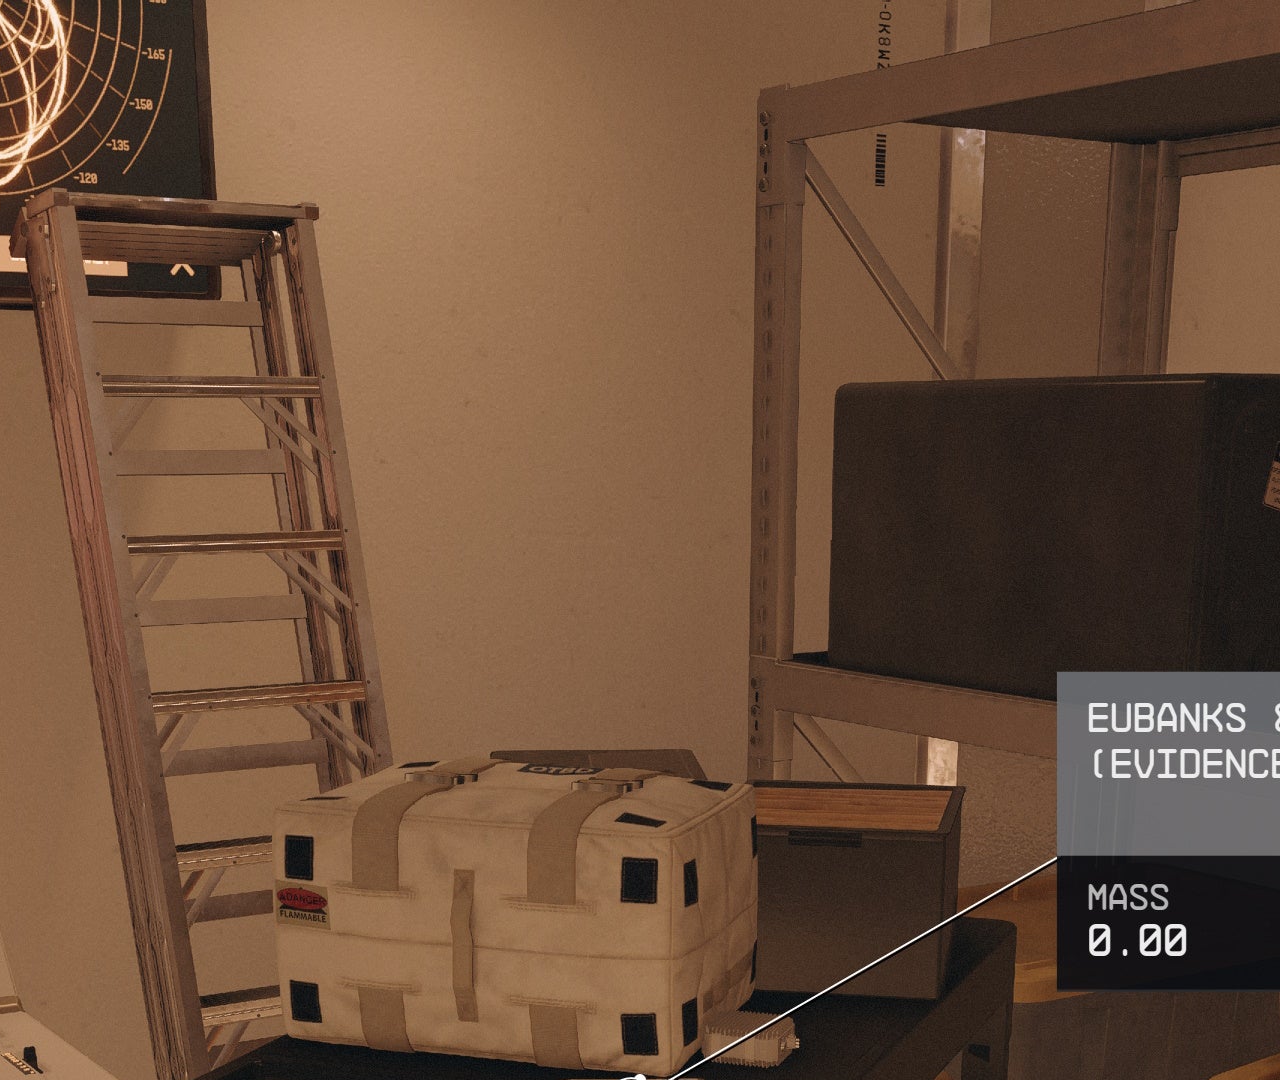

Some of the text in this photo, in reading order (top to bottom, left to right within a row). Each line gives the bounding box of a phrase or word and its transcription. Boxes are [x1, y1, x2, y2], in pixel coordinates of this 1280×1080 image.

[141, 48, 166, 61] -165
[128, 98, 154, 111] -150
[105, 139, 130, 152] -135
[73, 172, 98, 185] -120
[280, 910, 327, 923] FLAMMABLE
